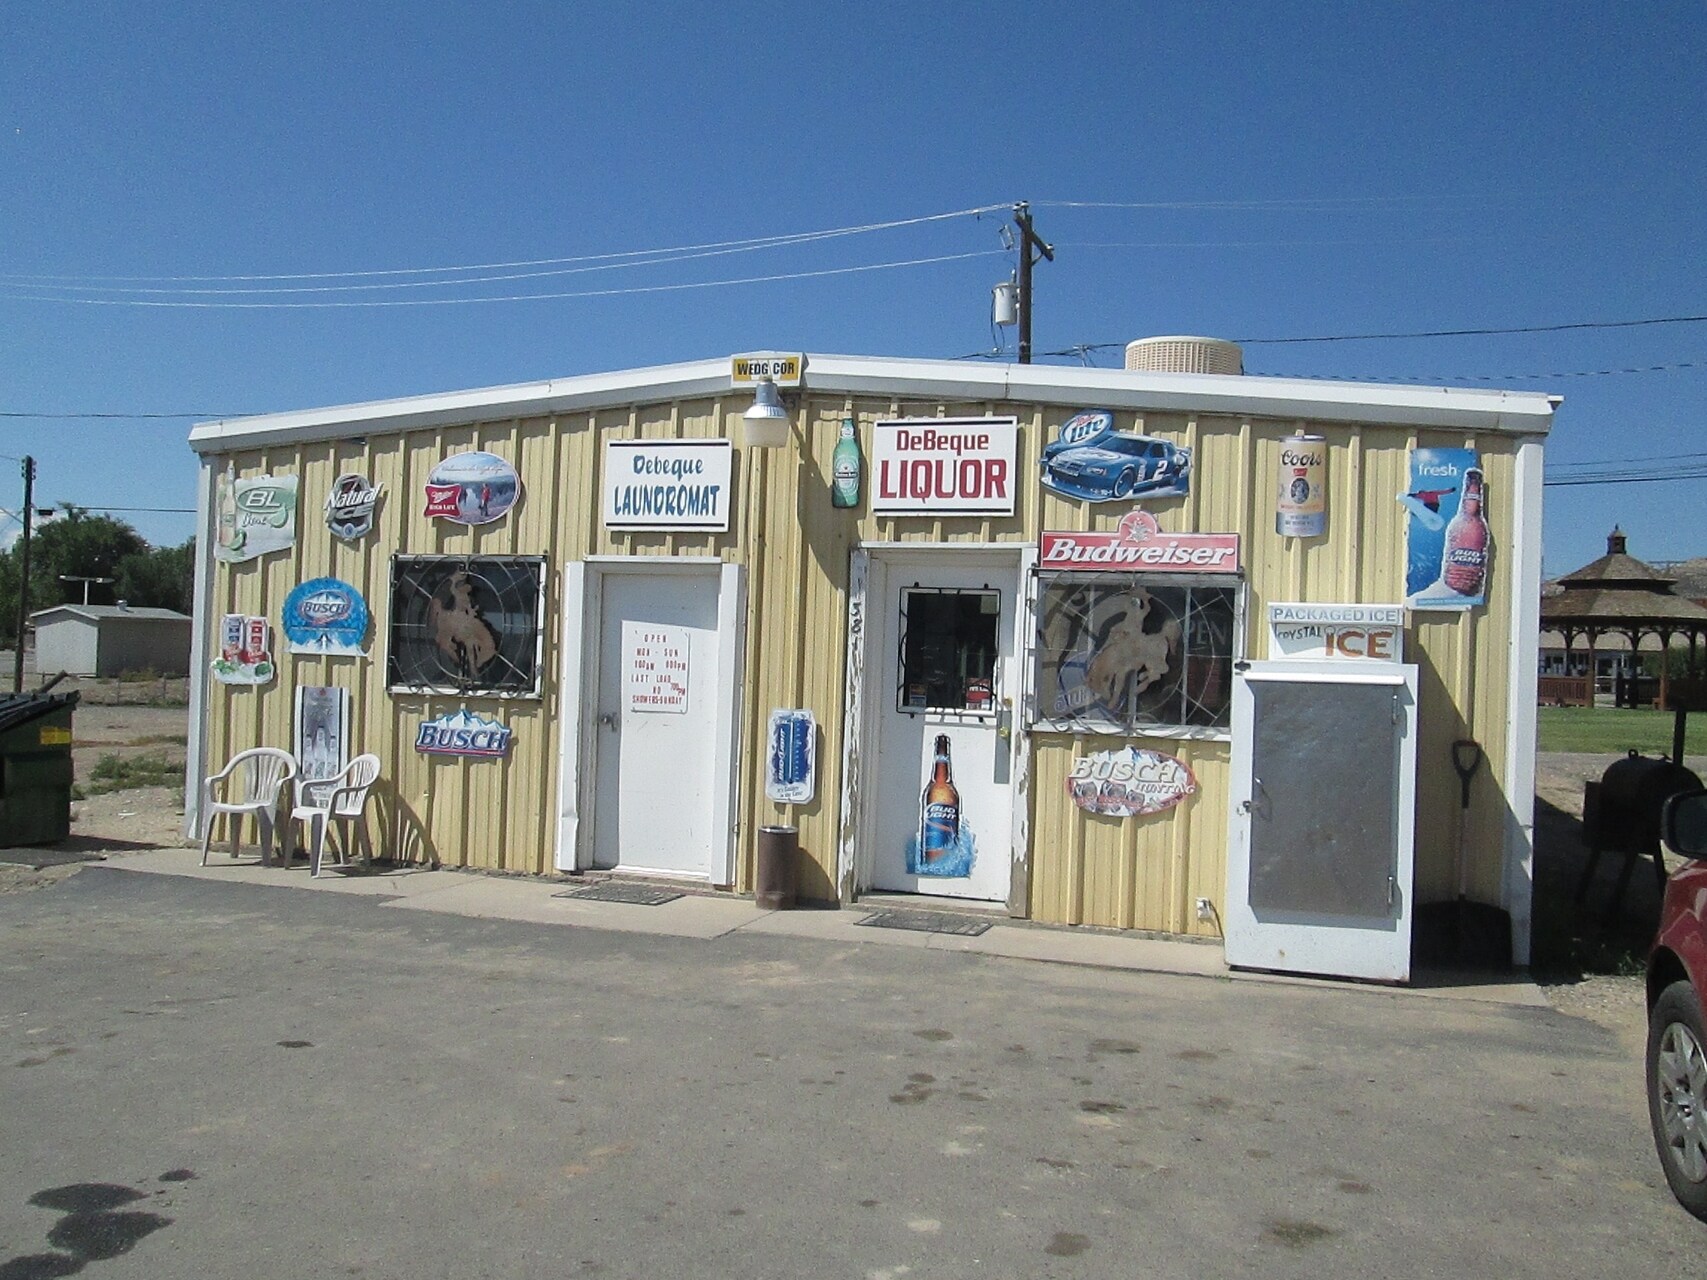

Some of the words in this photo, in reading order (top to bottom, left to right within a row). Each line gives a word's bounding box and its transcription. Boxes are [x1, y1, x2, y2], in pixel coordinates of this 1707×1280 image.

[737, 363, 769, 375] WEDG
[773, 362, 795, 374] COR
[896, 430, 989, 456] DeBeque
[1281, 449, 1322, 466] Coors
[633, 455, 704, 481] Debeque
[1152, 460, 1168, 481] 2
[1418, 462, 1457, 477] fresh
[879, 459, 1007, 504] LIQUOR
[245, 490, 281, 507] BL
[614, 484, 720, 516] LAUNDROMAT
[1043, 538, 1235, 565] Budweiser
[1449, 555, 1483, 564] LIGHT
[1455, 549, 1480, 558] BUD
[303, 600, 349, 614] BUSCH
[1273, 607, 1364, 621] PACKAGED
[1369, 609, 1397, 622] ICE
[1325, 630, 1392, 658] ICE
[419, 725, 510, 749] BUSCH
[1068, 757, 1178, 783] BUSCH
[1136, 783, 1196, 794] HUNTING
[926, 812, 957, 820] LIGHT
[930, 804, 956, 815] BUD
